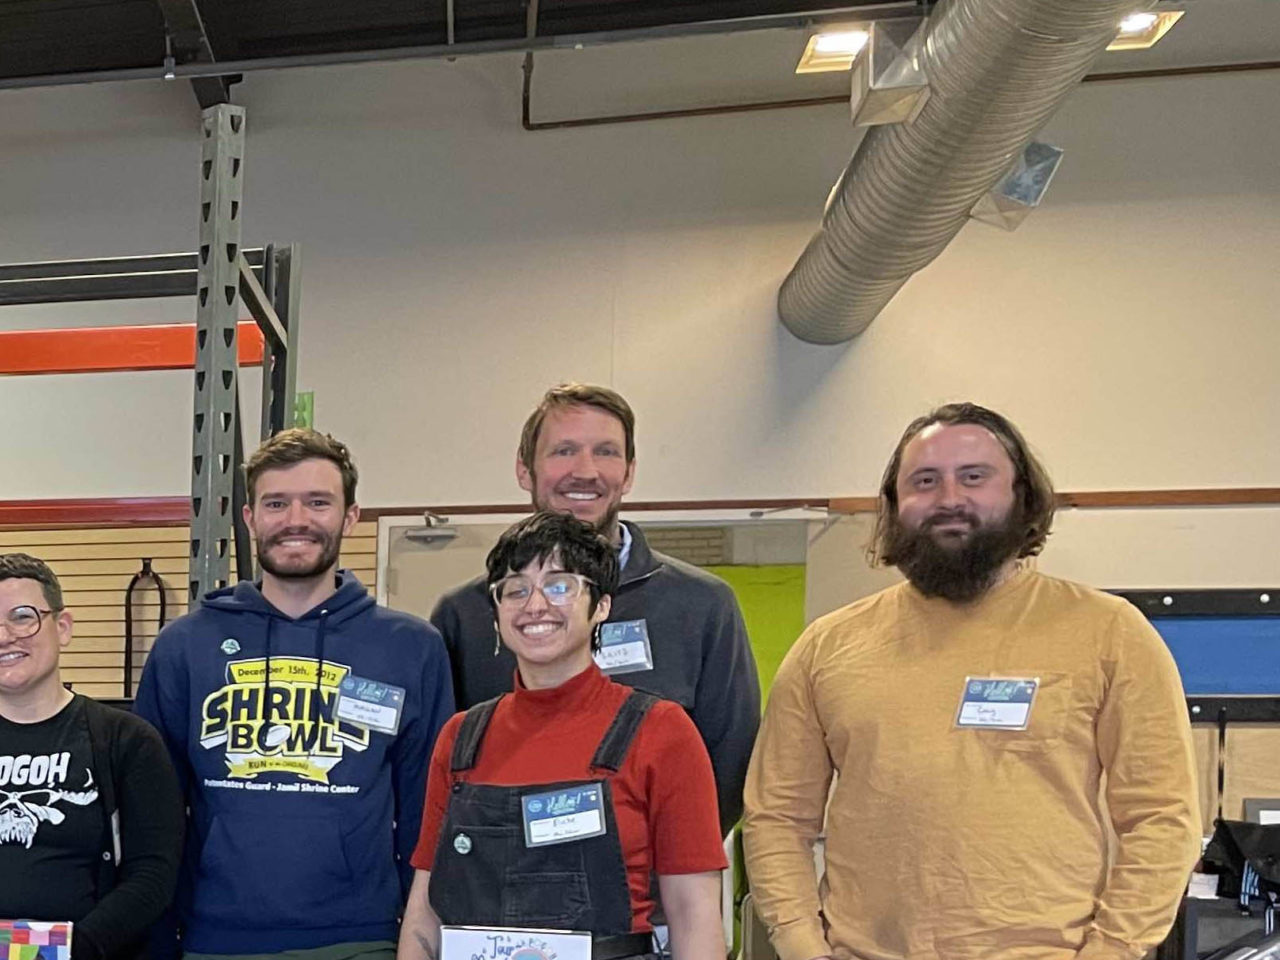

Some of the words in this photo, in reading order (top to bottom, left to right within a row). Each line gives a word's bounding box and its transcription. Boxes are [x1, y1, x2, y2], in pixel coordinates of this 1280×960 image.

[238, 665, 283, 677] December
[315, 668, 337, 681] 2012
[231, 722, 339, 752] BOWL
[245, 780, 271, 791] Guard
[301, 783, 329, 793] Shrine
[330, 784, 360, 794] Center
